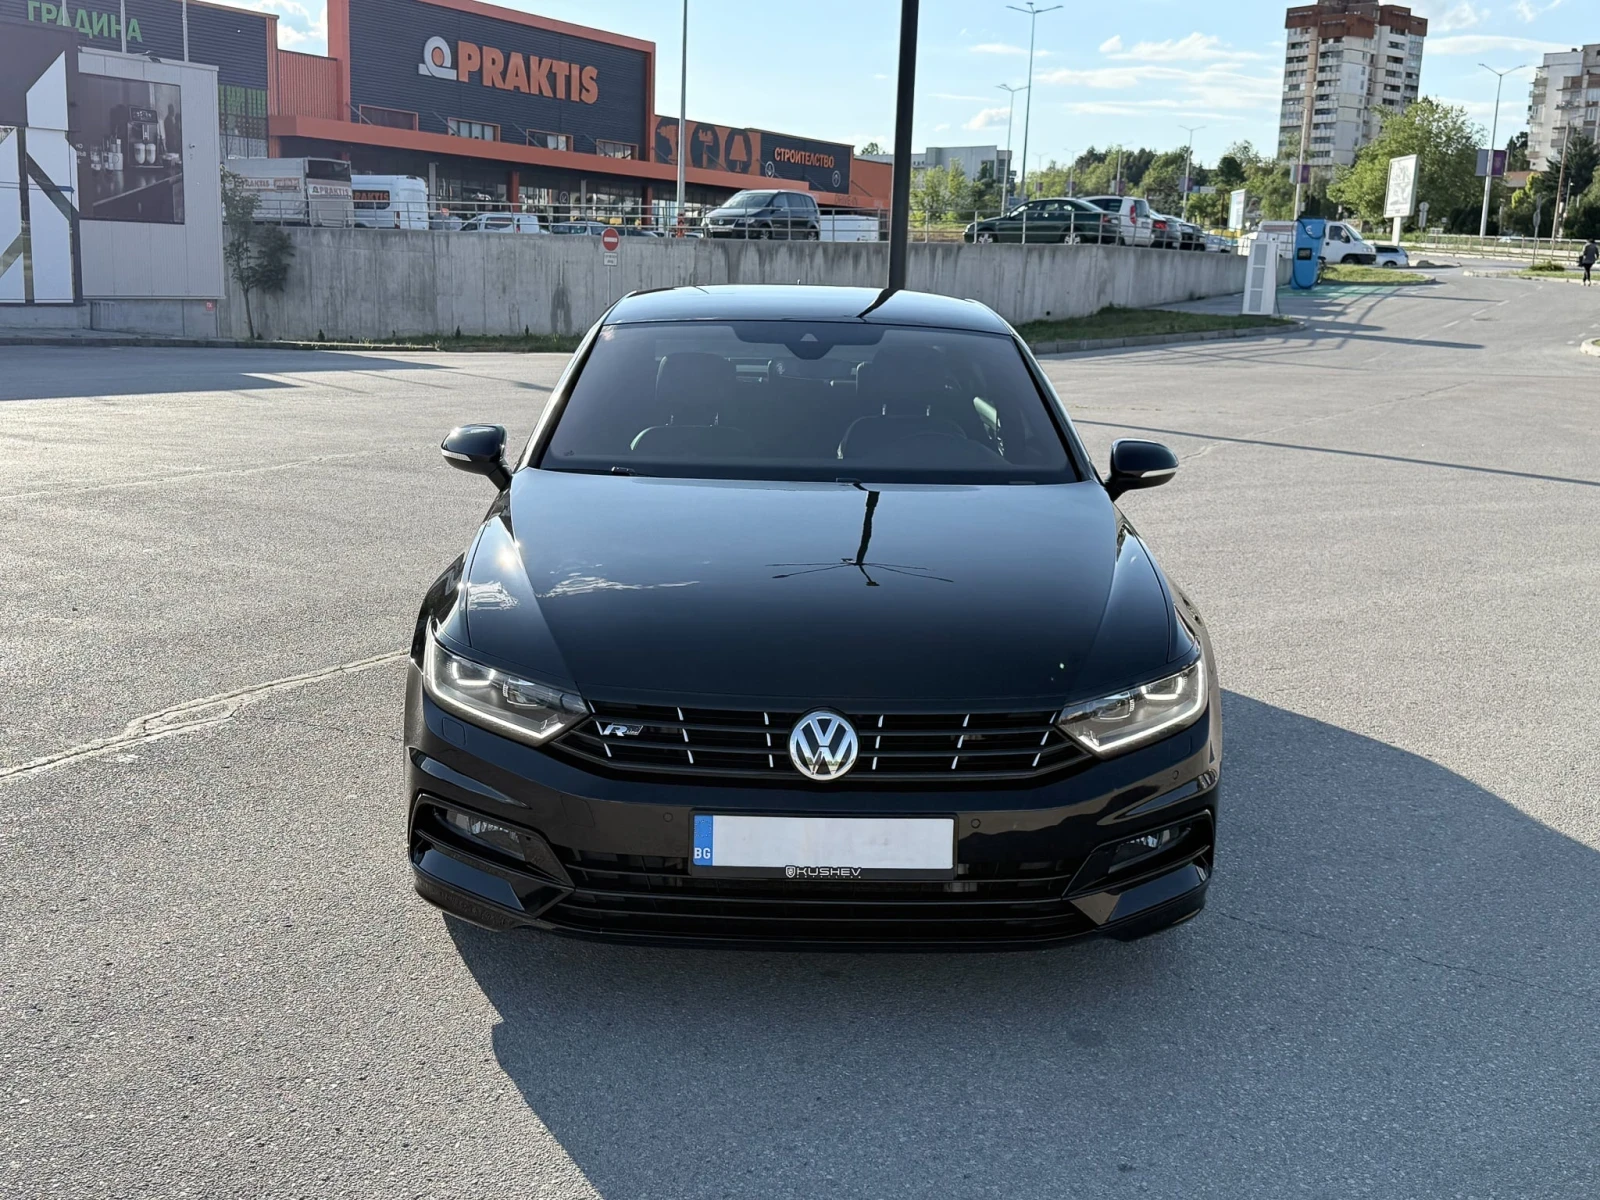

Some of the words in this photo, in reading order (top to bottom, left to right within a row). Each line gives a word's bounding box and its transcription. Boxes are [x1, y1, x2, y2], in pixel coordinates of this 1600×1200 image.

[27, 0, 143, 43] ГРАДИНА
[457, 40, 599, 105] PRAKTIS
[774, 147, 835, 169] СТРОИТЕЛСТВО
[352, 191, 389, 201] RAKTIS
[693, 847, 712, 860] BG
[796, 867, 862, 877] KUSHEV
